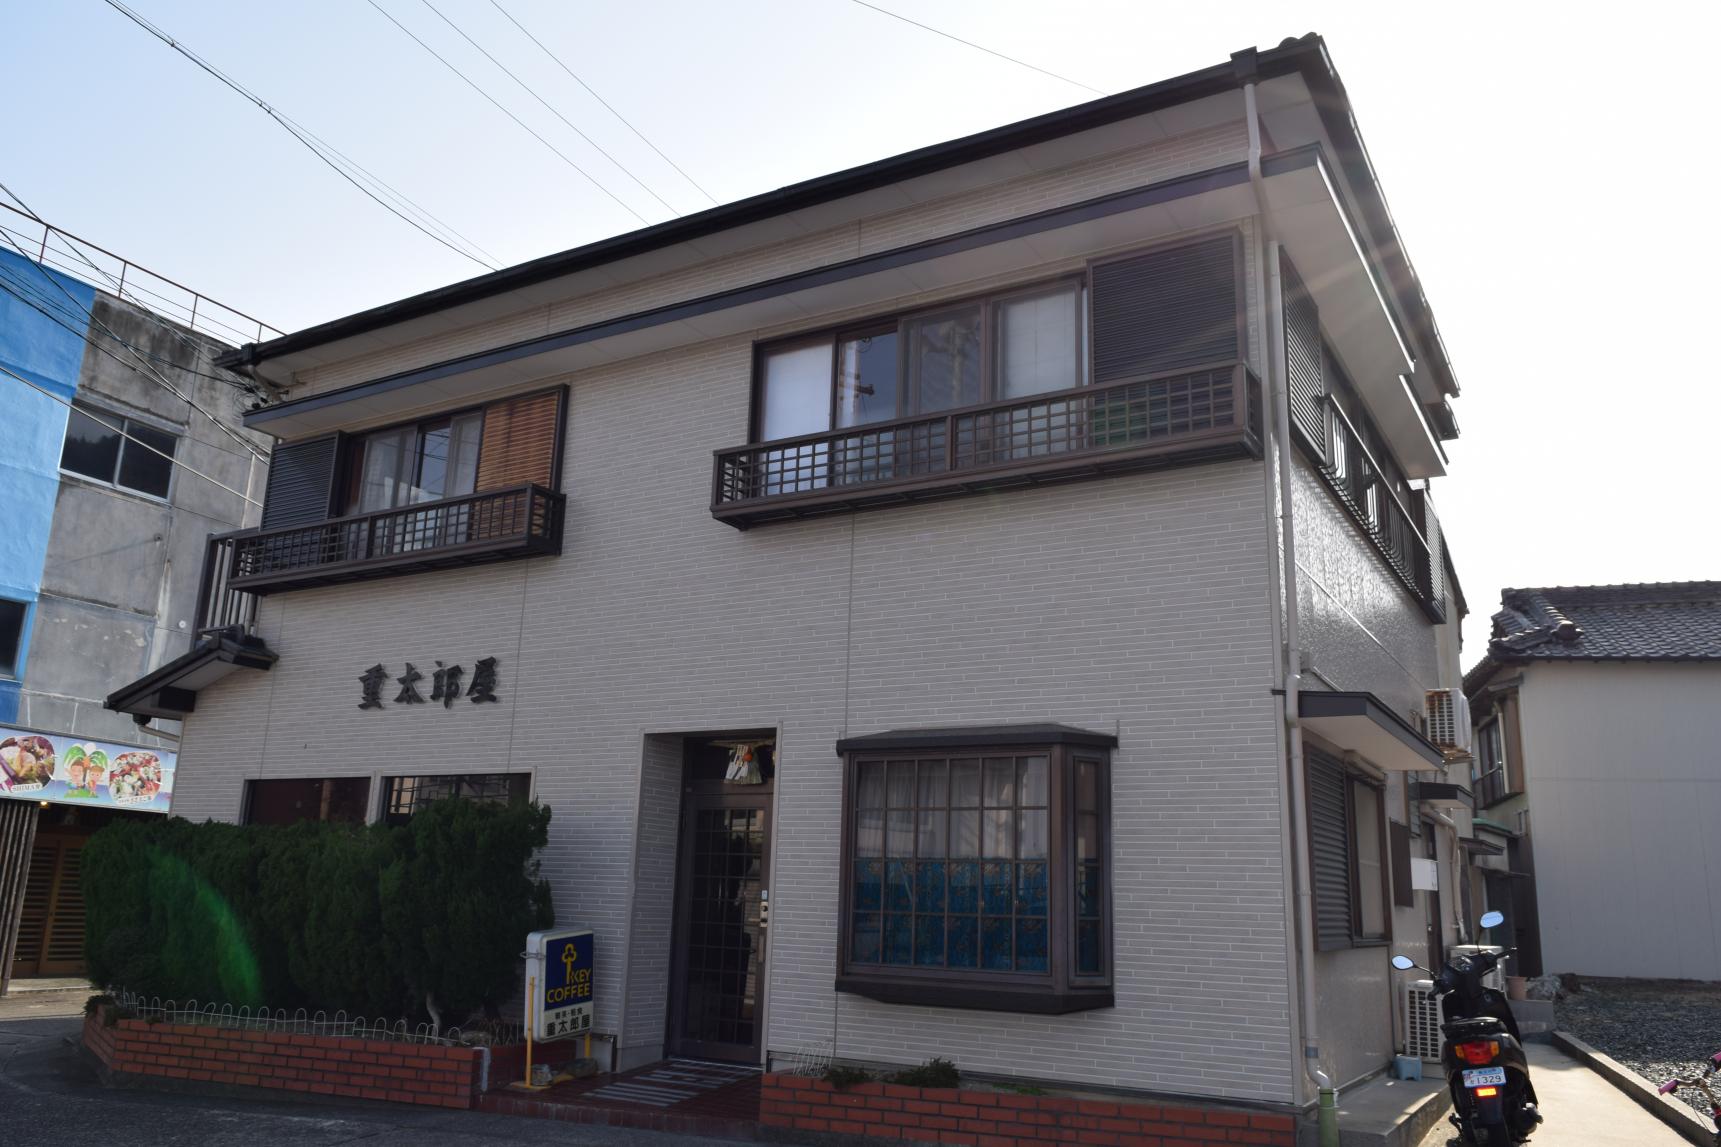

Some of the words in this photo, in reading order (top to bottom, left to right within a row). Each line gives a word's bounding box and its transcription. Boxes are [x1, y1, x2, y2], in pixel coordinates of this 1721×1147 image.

[357, 656, 499, 710] 重太郎屋
[569, 968, 592, 984] KEY
[546, 982, 591, 1004] COFFEE
[546, 1014, 591, 1037] 重太郎屋
[1477, 1075, 1502, 1084] 1329
